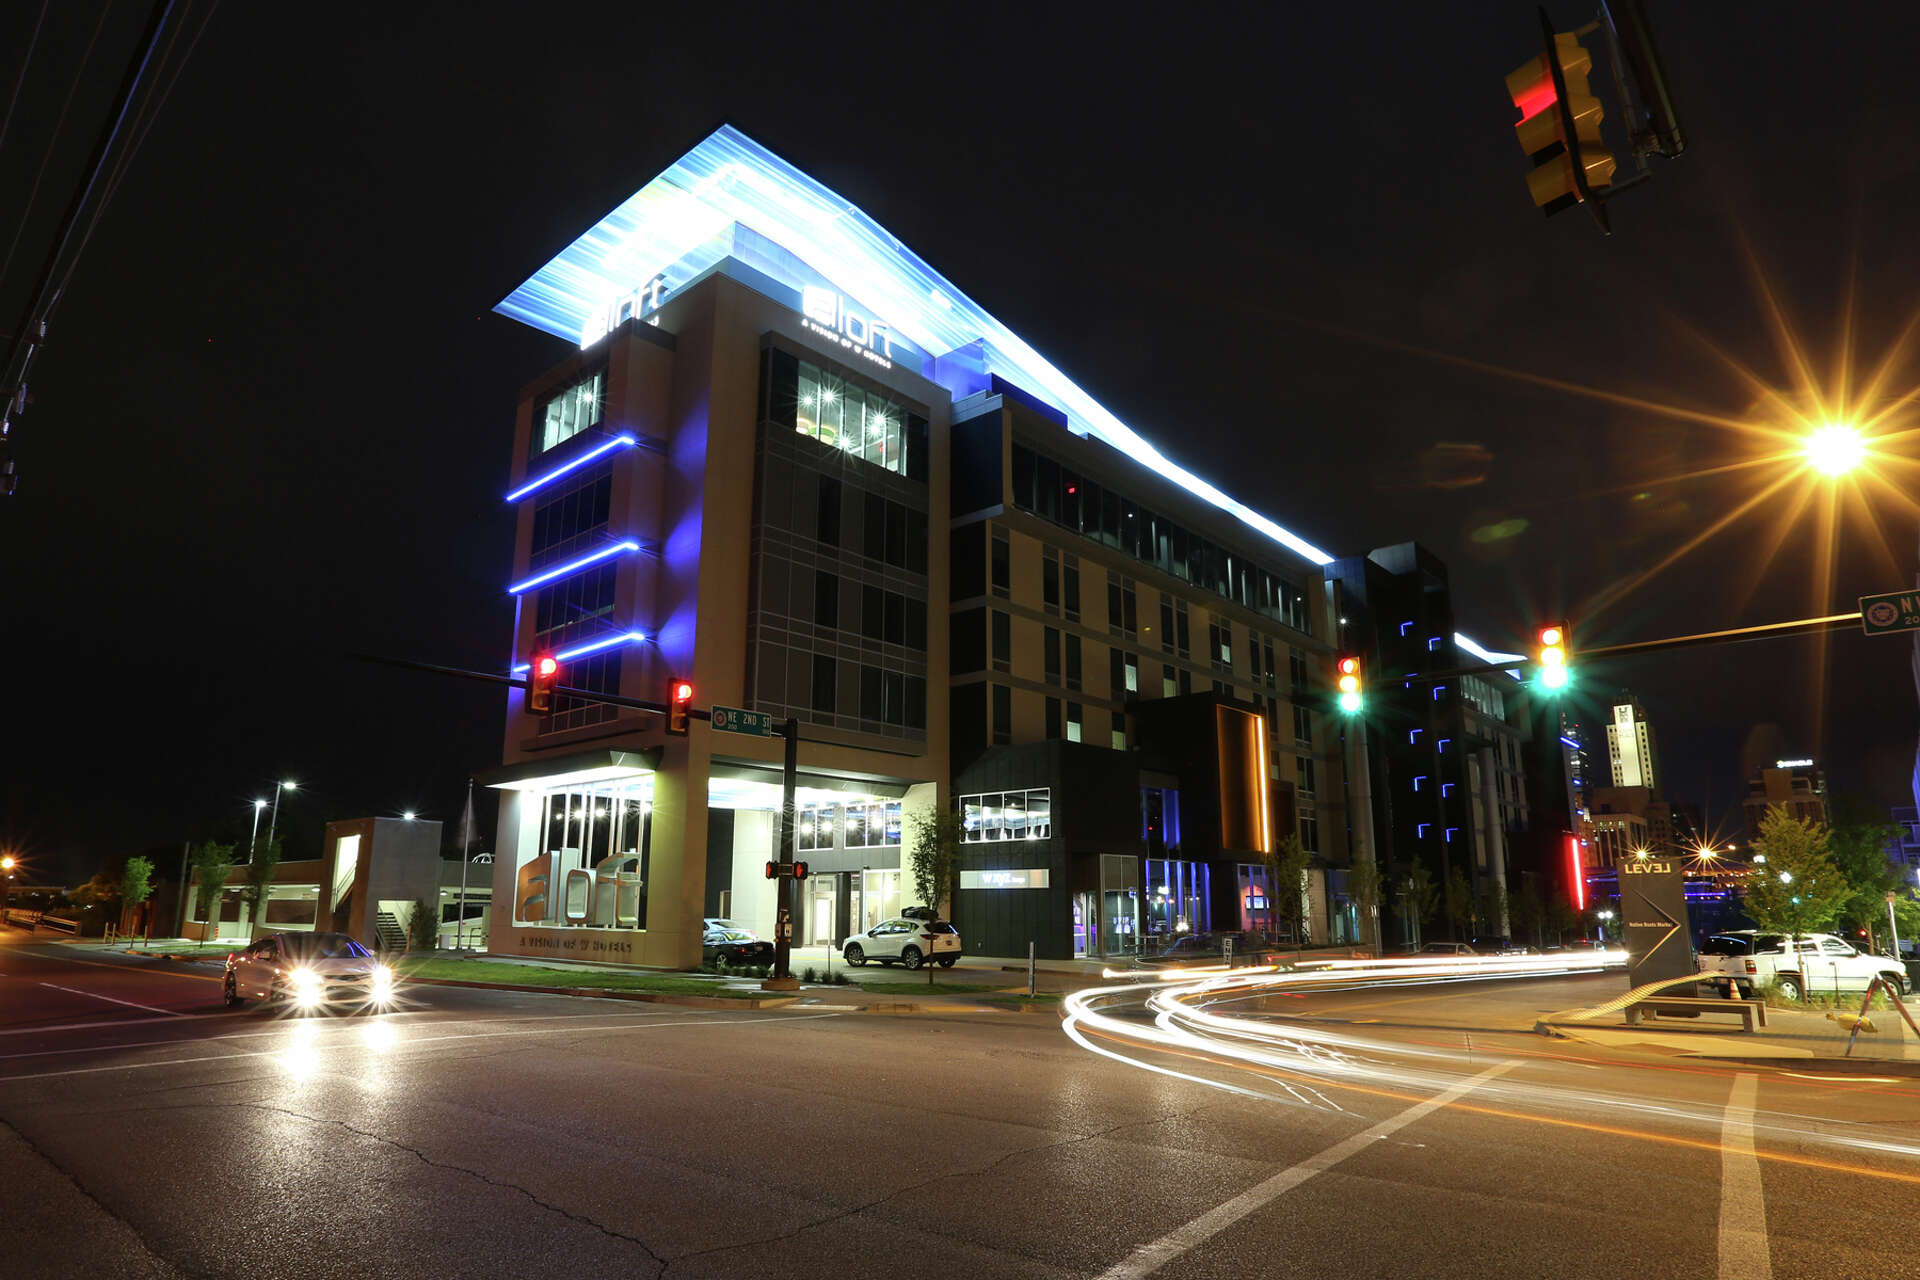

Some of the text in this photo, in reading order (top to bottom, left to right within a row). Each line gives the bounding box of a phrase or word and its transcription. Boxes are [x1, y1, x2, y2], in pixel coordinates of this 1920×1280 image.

[801, 318, 809, 328] A
[727, 711, 771, 729] NE 2ND ST
[1624, 863, 1672, 874] LEVEL
[515, 847, 643, 926] aloft
